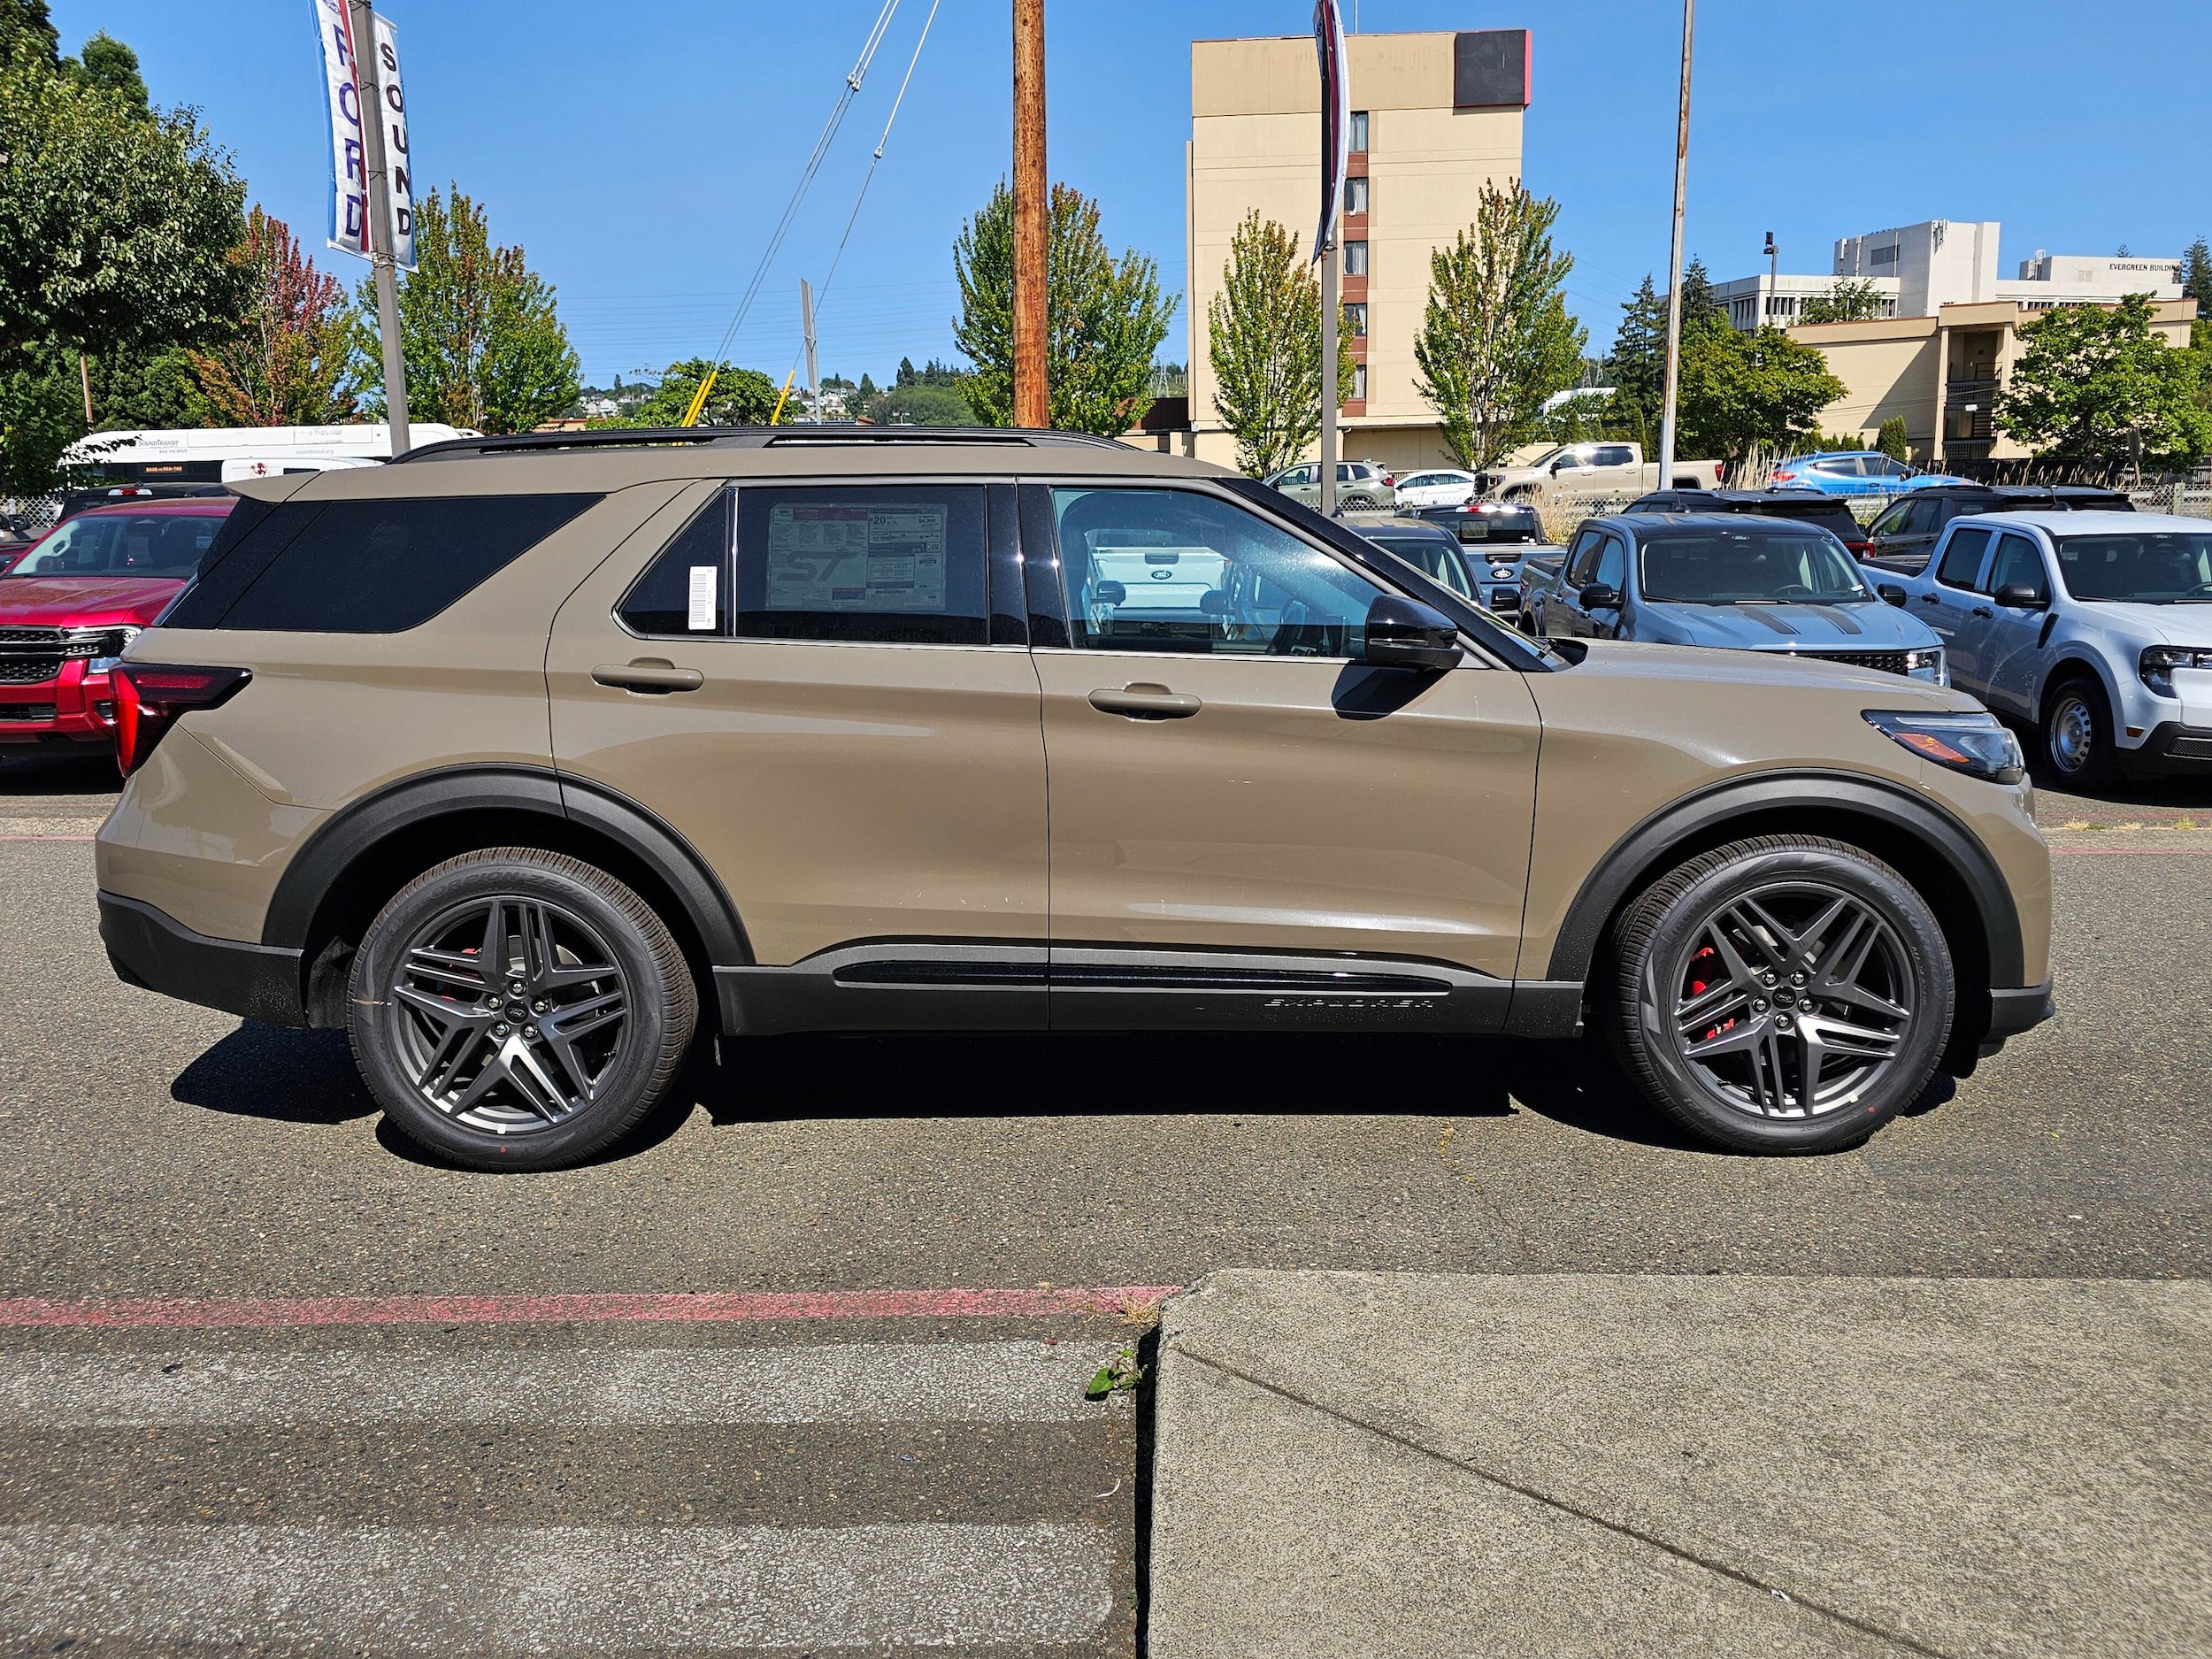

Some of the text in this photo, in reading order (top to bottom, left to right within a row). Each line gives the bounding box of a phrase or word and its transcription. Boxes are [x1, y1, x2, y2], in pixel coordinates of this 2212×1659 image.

[333, 22, 362, 238] FORD
[380, 42, 411, 236] SOUND
[776, 550, 861, 582] ST
[873, 516, 887, 525] 20
